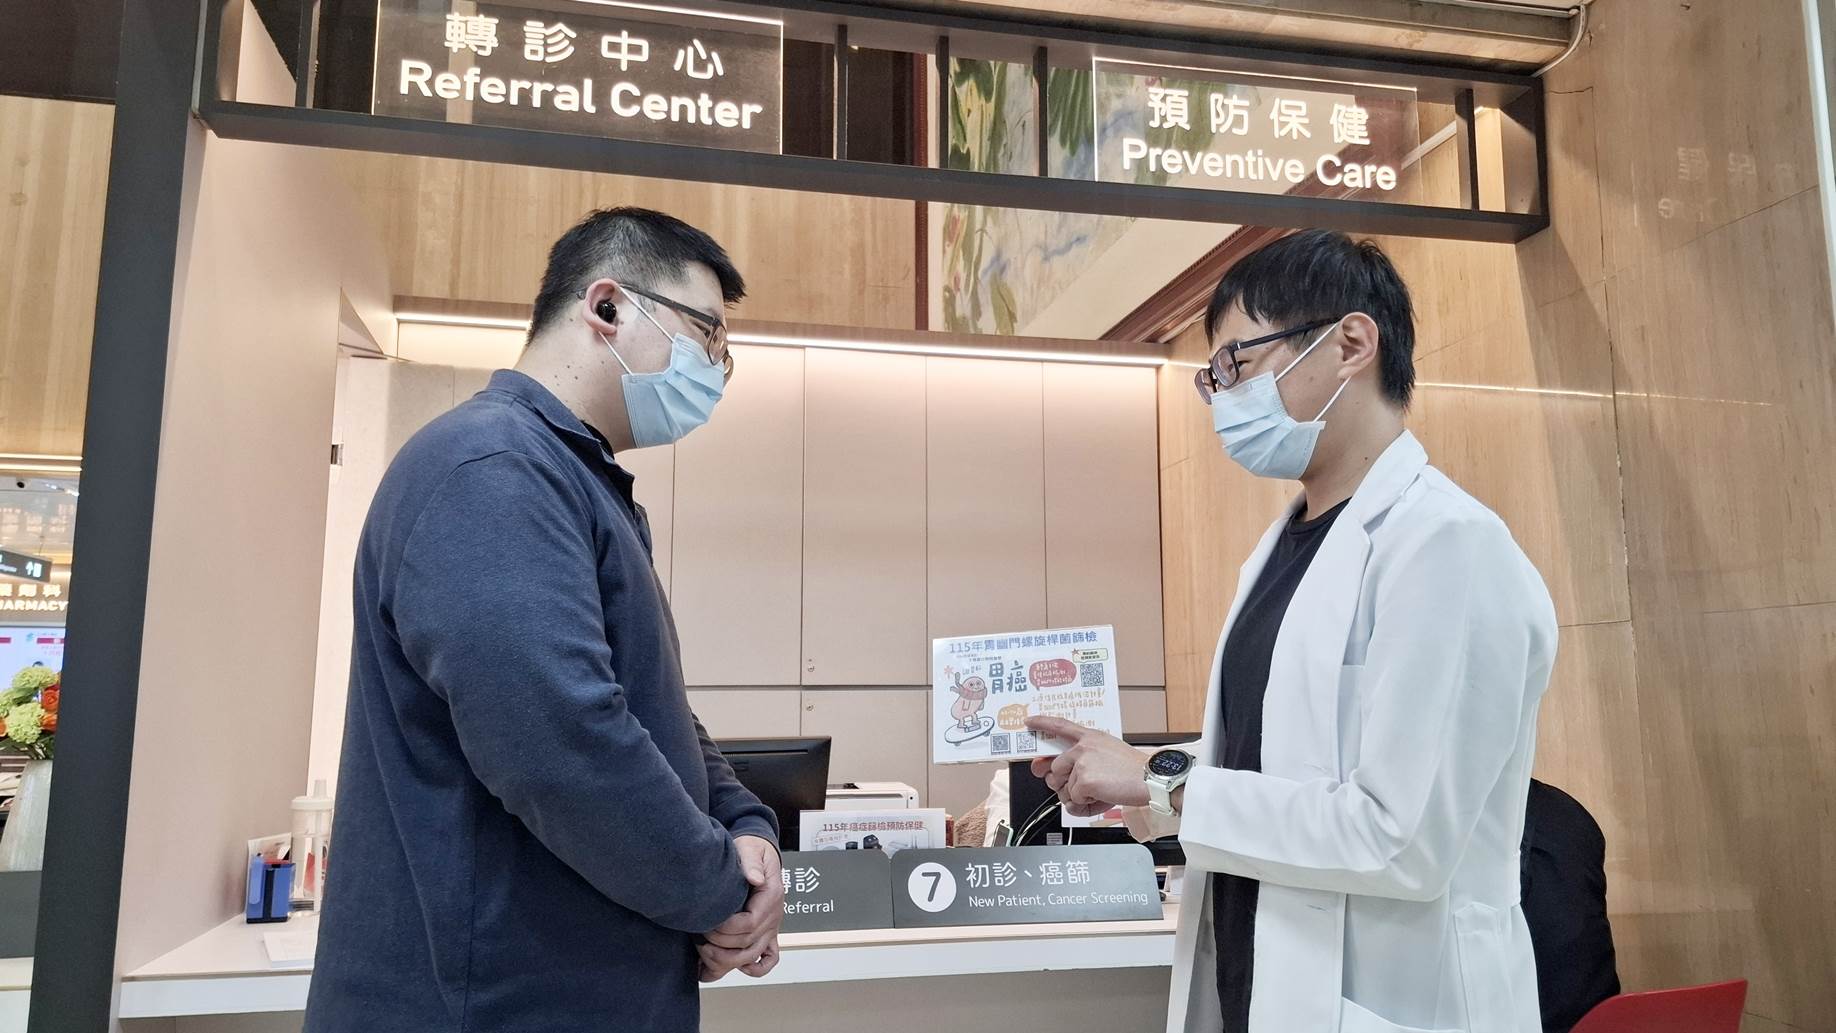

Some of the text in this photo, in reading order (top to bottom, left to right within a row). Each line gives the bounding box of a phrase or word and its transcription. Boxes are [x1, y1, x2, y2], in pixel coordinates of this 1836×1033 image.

[444, 12, 724, 80] 轉診中心
[399, 59, 764, 130] Referral Center
[1147, 87, 1371, 146] 預防保健
[1122, 138, 1397, 191] Preventive Care
[921, 871, 942, 903] 7
[965, 860, 1091, 888] 初診、癌篩
[968, 891, 1149, 908] New Patient, Cancer Screening
